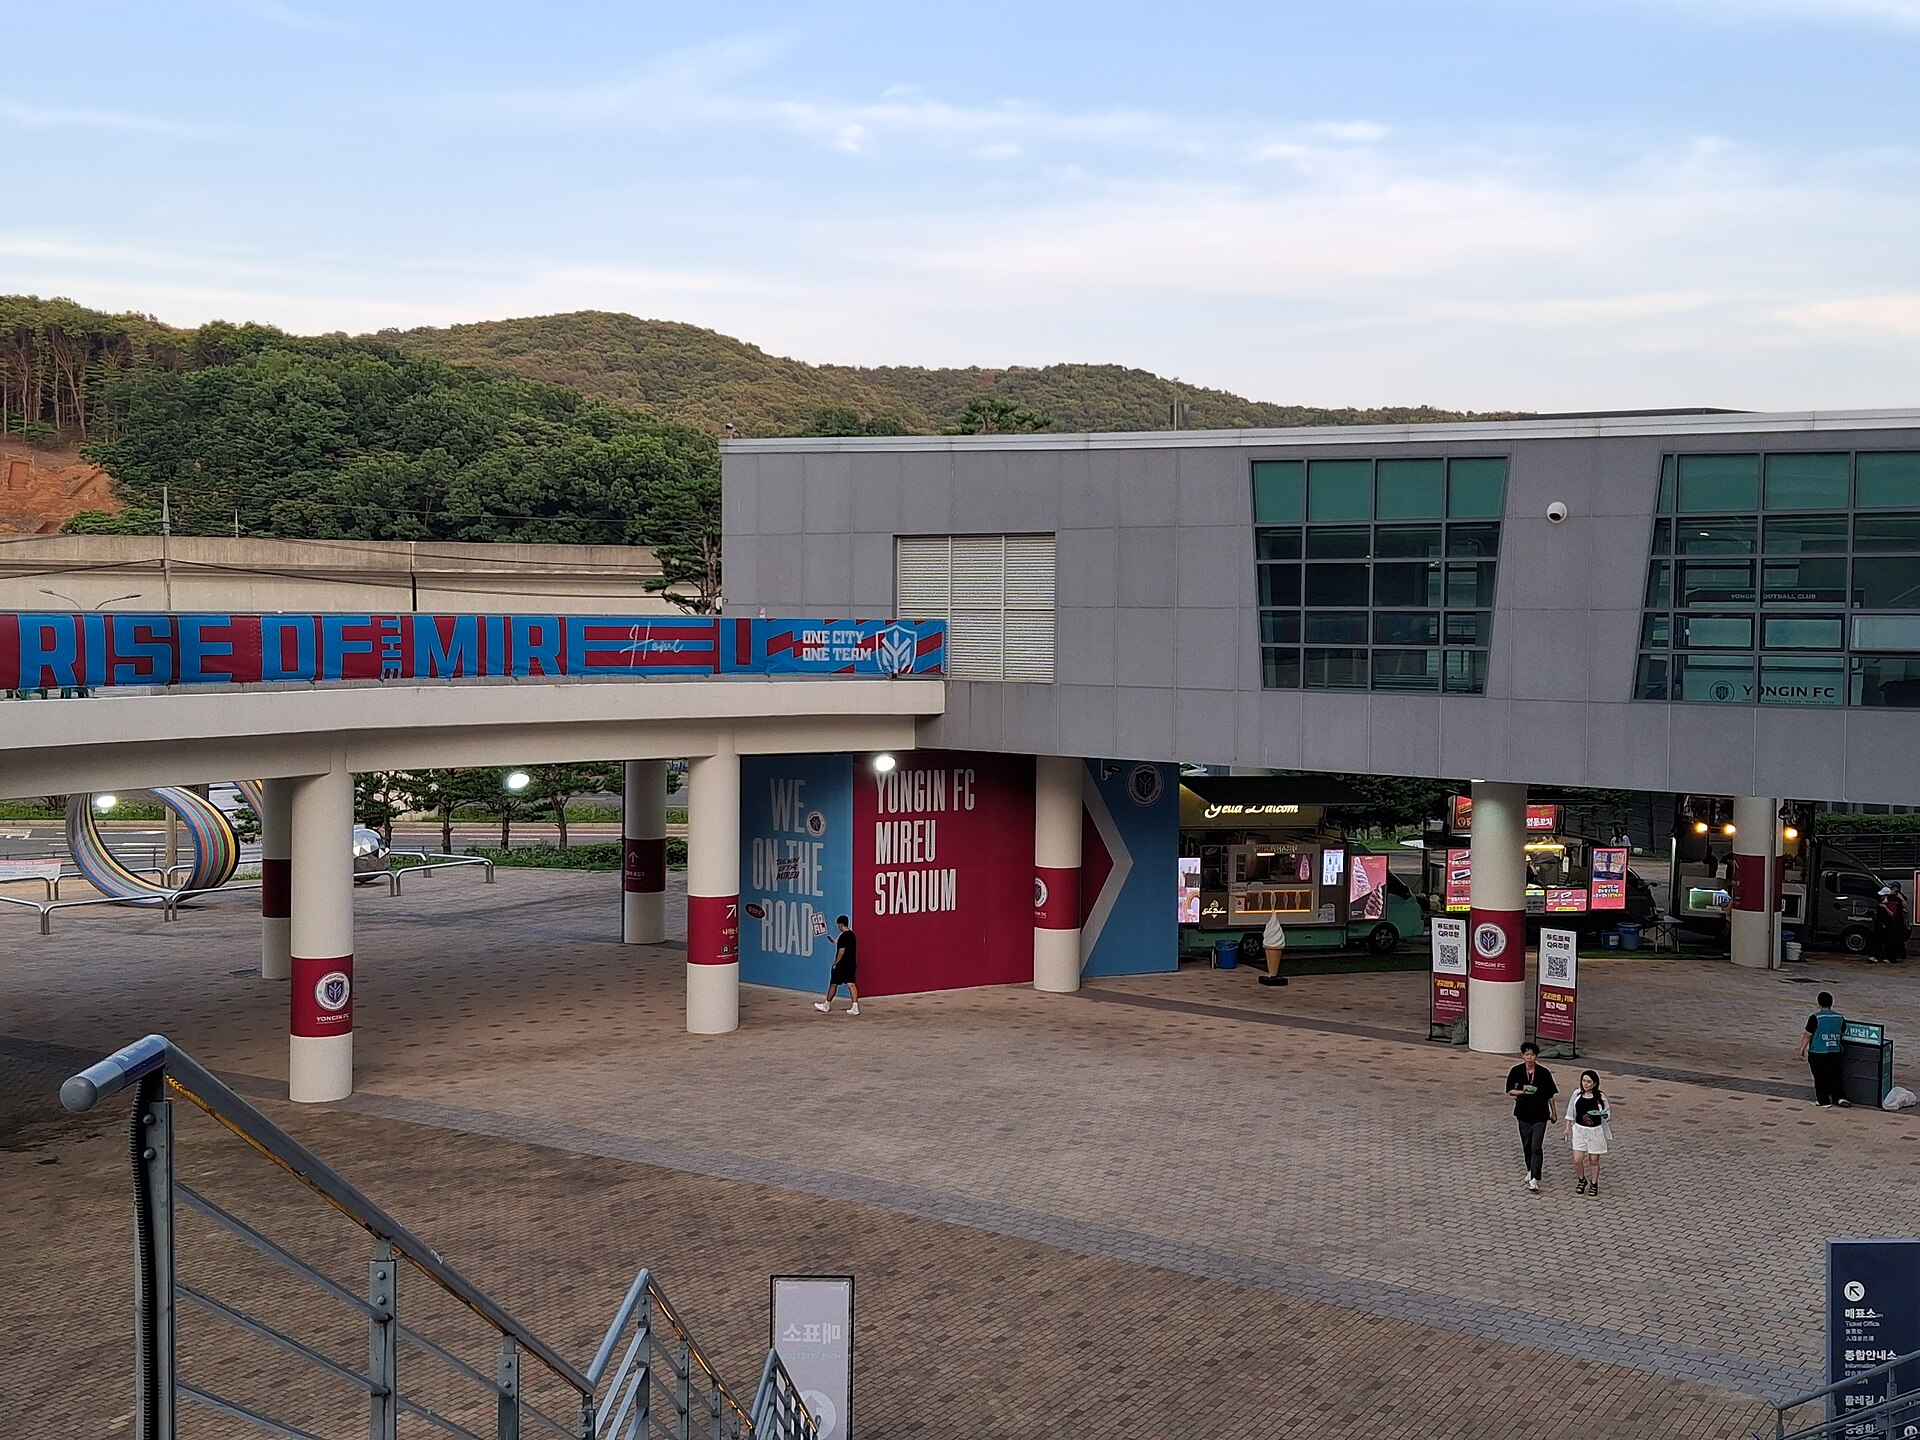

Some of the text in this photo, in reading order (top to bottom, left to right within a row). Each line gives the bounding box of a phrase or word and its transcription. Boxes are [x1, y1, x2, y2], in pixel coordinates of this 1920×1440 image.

[17, 614, 233, 688] RISE
[261, 614, 374, 684] OF
[381, 616, 402, 679] THE
[619, 621, 685, 670] Home
[802, 630, 865, 646] ONE CITY
[802, 646, 873, 663] ONE TEAM
[1813, 687, 1835, 698] FC
[769, 777, 805, 833] WE
[875, 768, 975, 814] YONGIN FC
[875, 819, 936, 865] MIREU
[752, 837, 823, 897] ON THE
[875, 868, 957, 916] STADIUM
[761, 898, 814, 957] ROAD
[1845, 1308, 1876, 1319] 매표소
[1844, 1349, 1898, 1361] 종합안내소
[1845, 1423, 1878, 1435] 공중화
